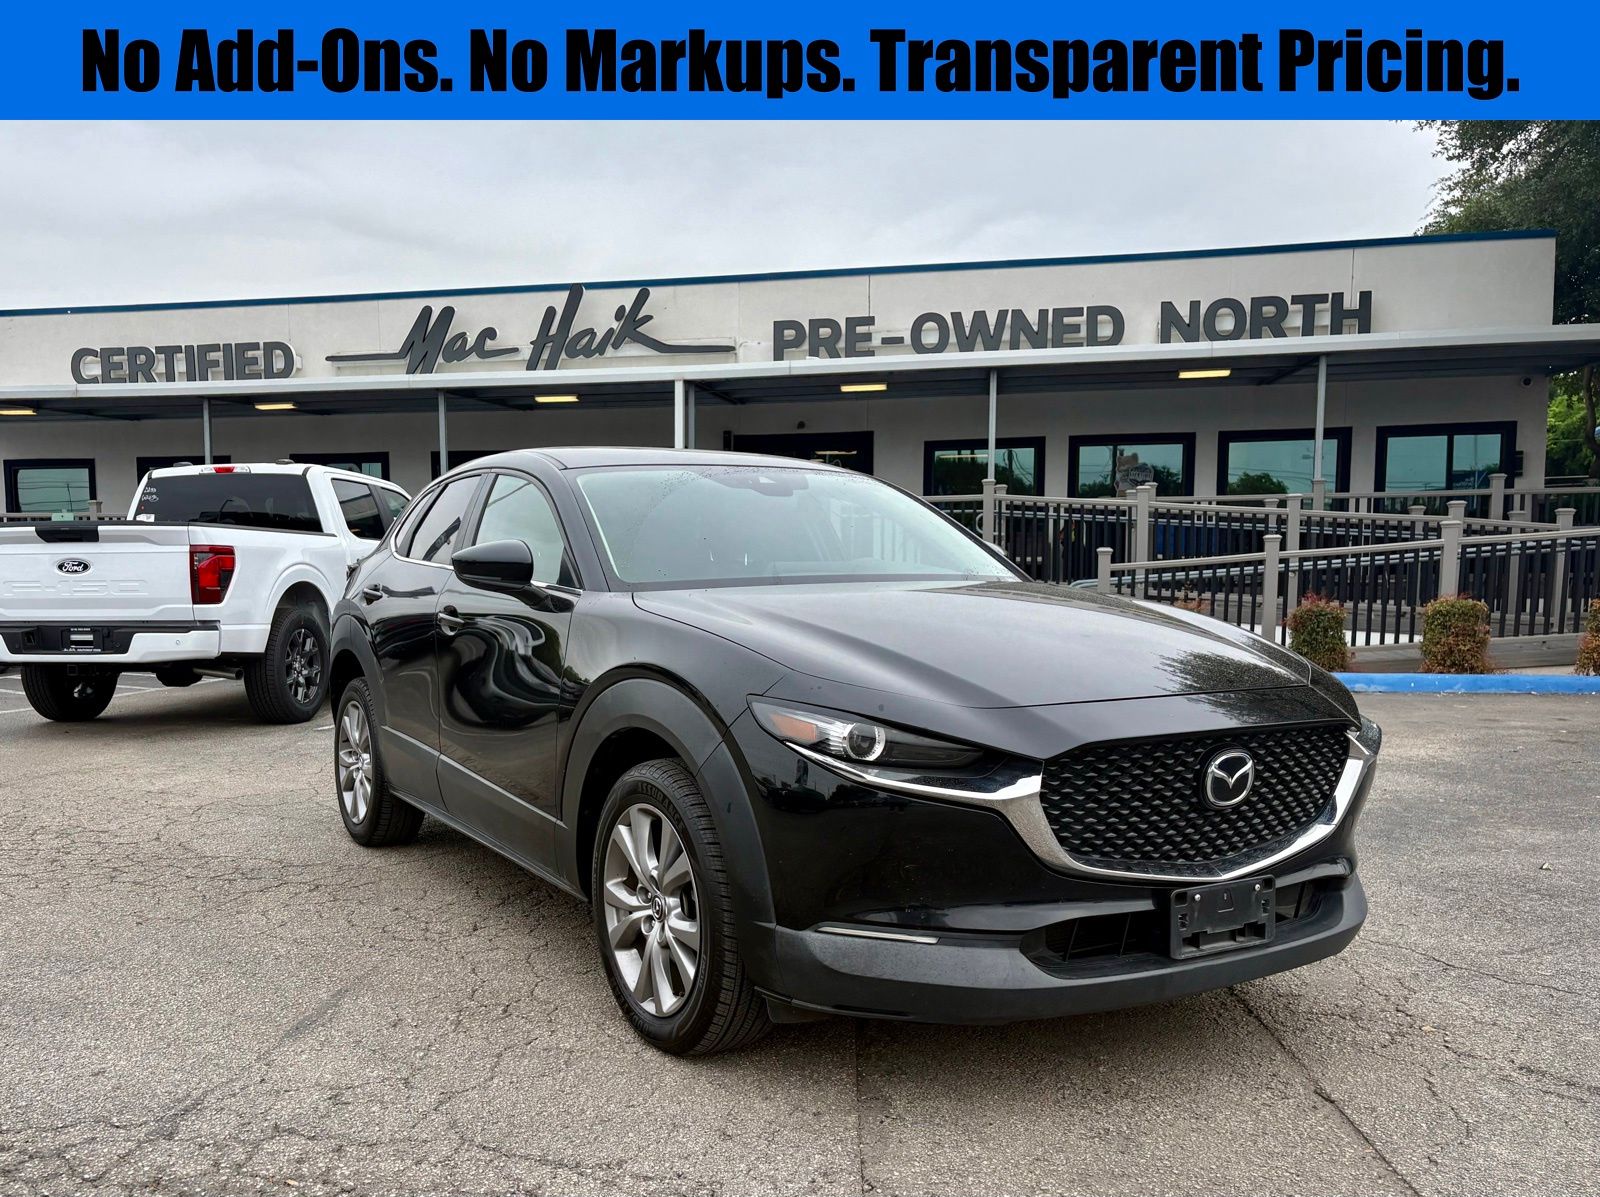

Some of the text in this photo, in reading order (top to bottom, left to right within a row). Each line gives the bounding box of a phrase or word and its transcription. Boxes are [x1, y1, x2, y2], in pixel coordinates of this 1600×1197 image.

[70, 283, 1373, 385] CERTIFIED Mac Haik PRE-OWNED NORTH
[62, 560, 85, 572] Ford
